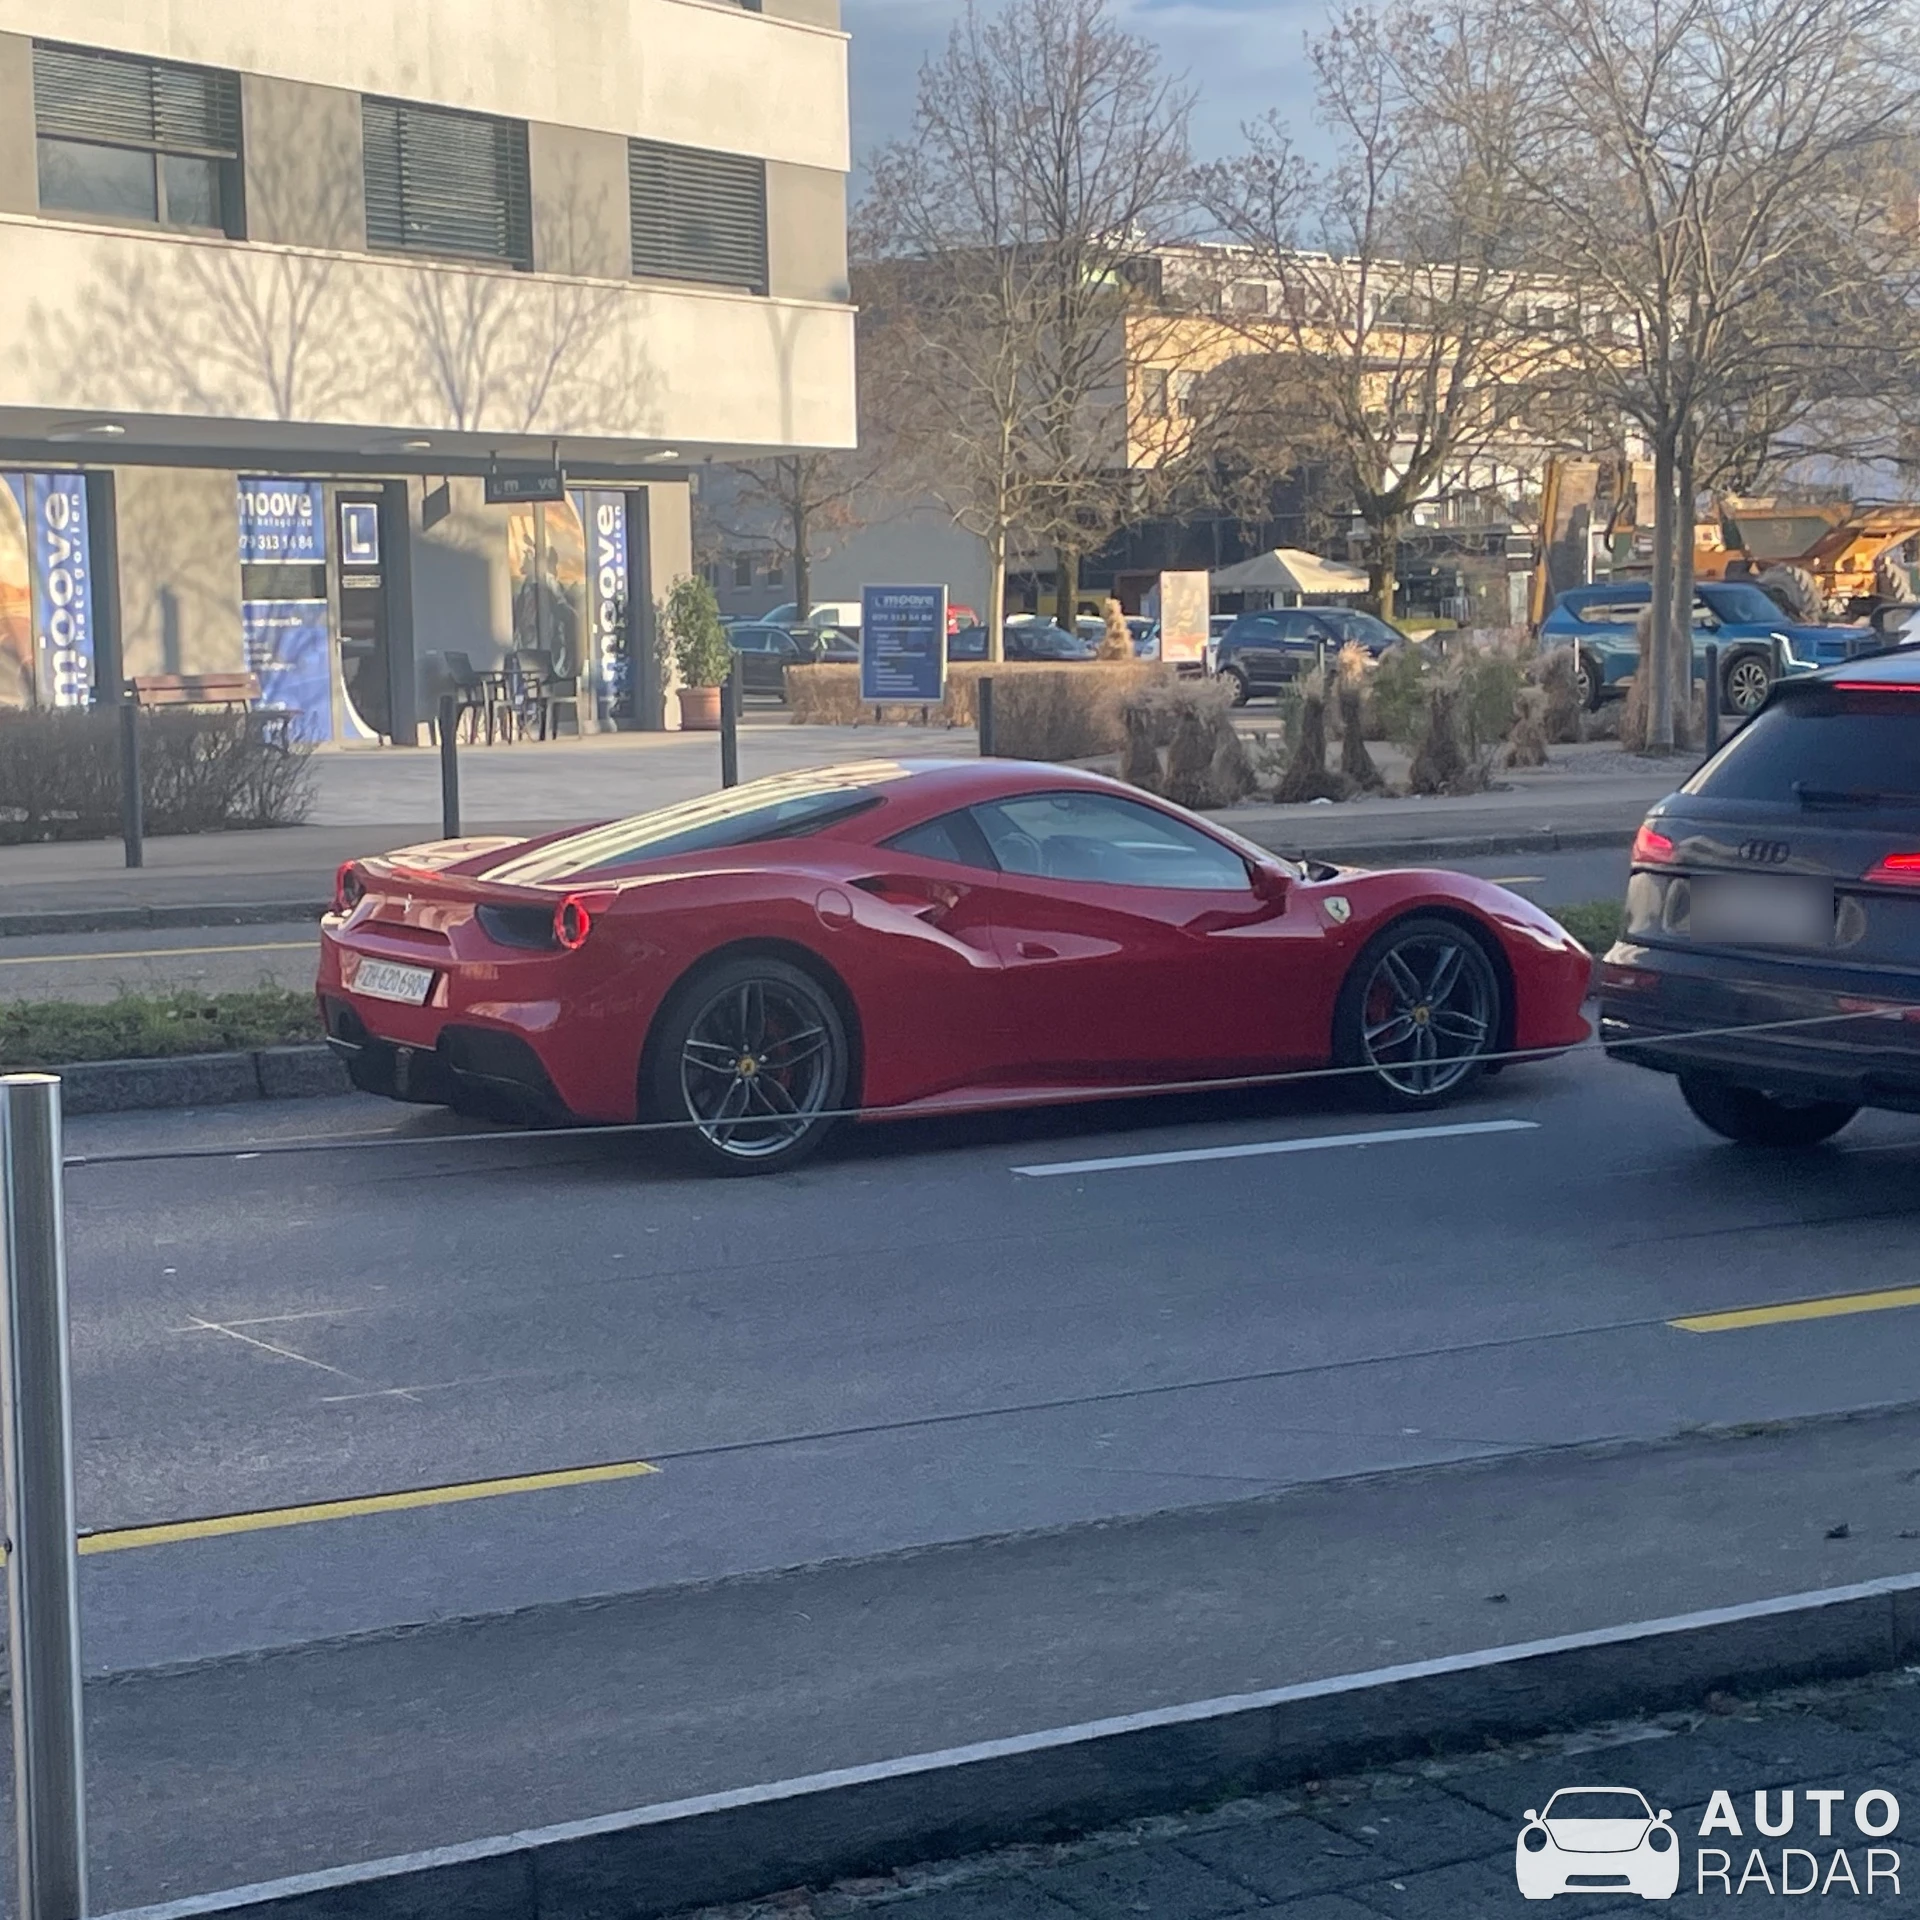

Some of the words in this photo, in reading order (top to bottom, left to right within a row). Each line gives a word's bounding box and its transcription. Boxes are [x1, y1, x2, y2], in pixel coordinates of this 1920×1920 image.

[258, 535, 279, 550] 313
[350, 514, 371, 553] L
[46, 493, 78, 707] moove
[597, 504, 616, 682] moove
